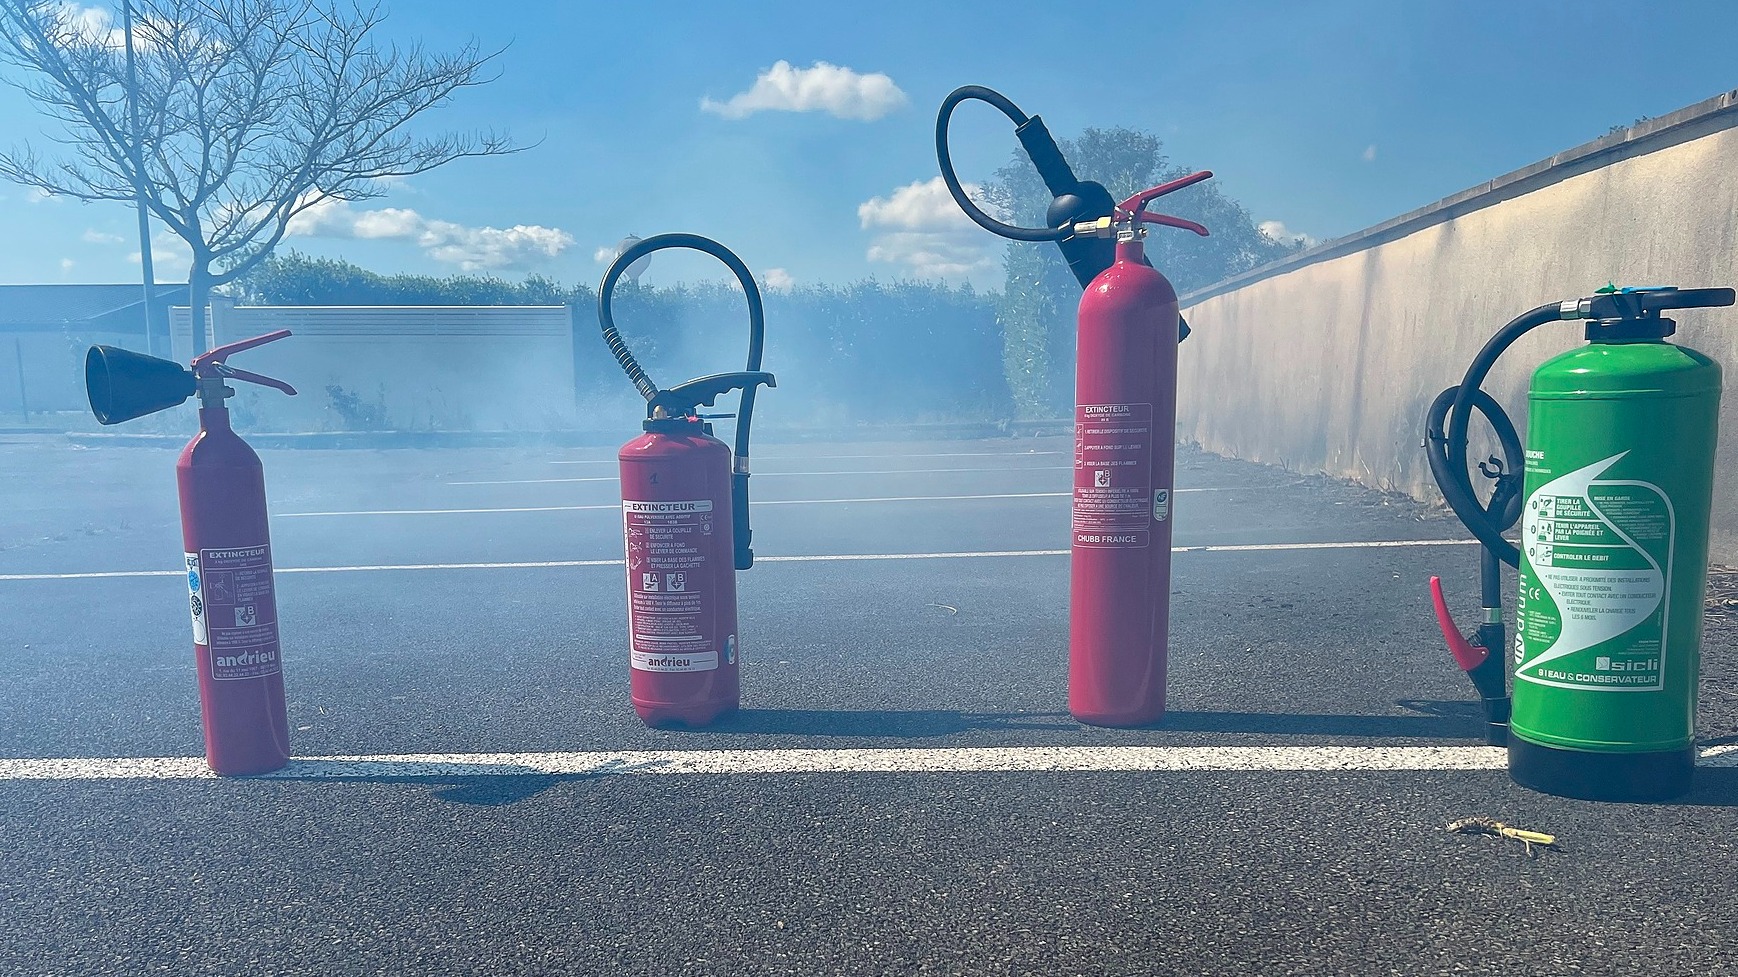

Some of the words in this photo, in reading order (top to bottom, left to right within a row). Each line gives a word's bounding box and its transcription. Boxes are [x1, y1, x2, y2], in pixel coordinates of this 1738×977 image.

[633, 503, 695, 511] EXTINCTEUR
[1077, 535, 1100, 543] CHUBB
[1101, 535, 1137, 543] FRANCE
[210, 549, 265, 559] EXTINCTEUR
[652, 573, 658, 581] A
[677, 573, 684, 581] B
[248, 606, 255, 615] B
[217, 650, 275, 667] andrieu
[648, 656, 690, 667] andrieu
[1611, 658, 1658, 671] sicli
[1548, 670, 1566, 679] EAU
[1567, 673, 1574, 681] &
[1575, 673, 1657, 683] CONSERVATEUR
